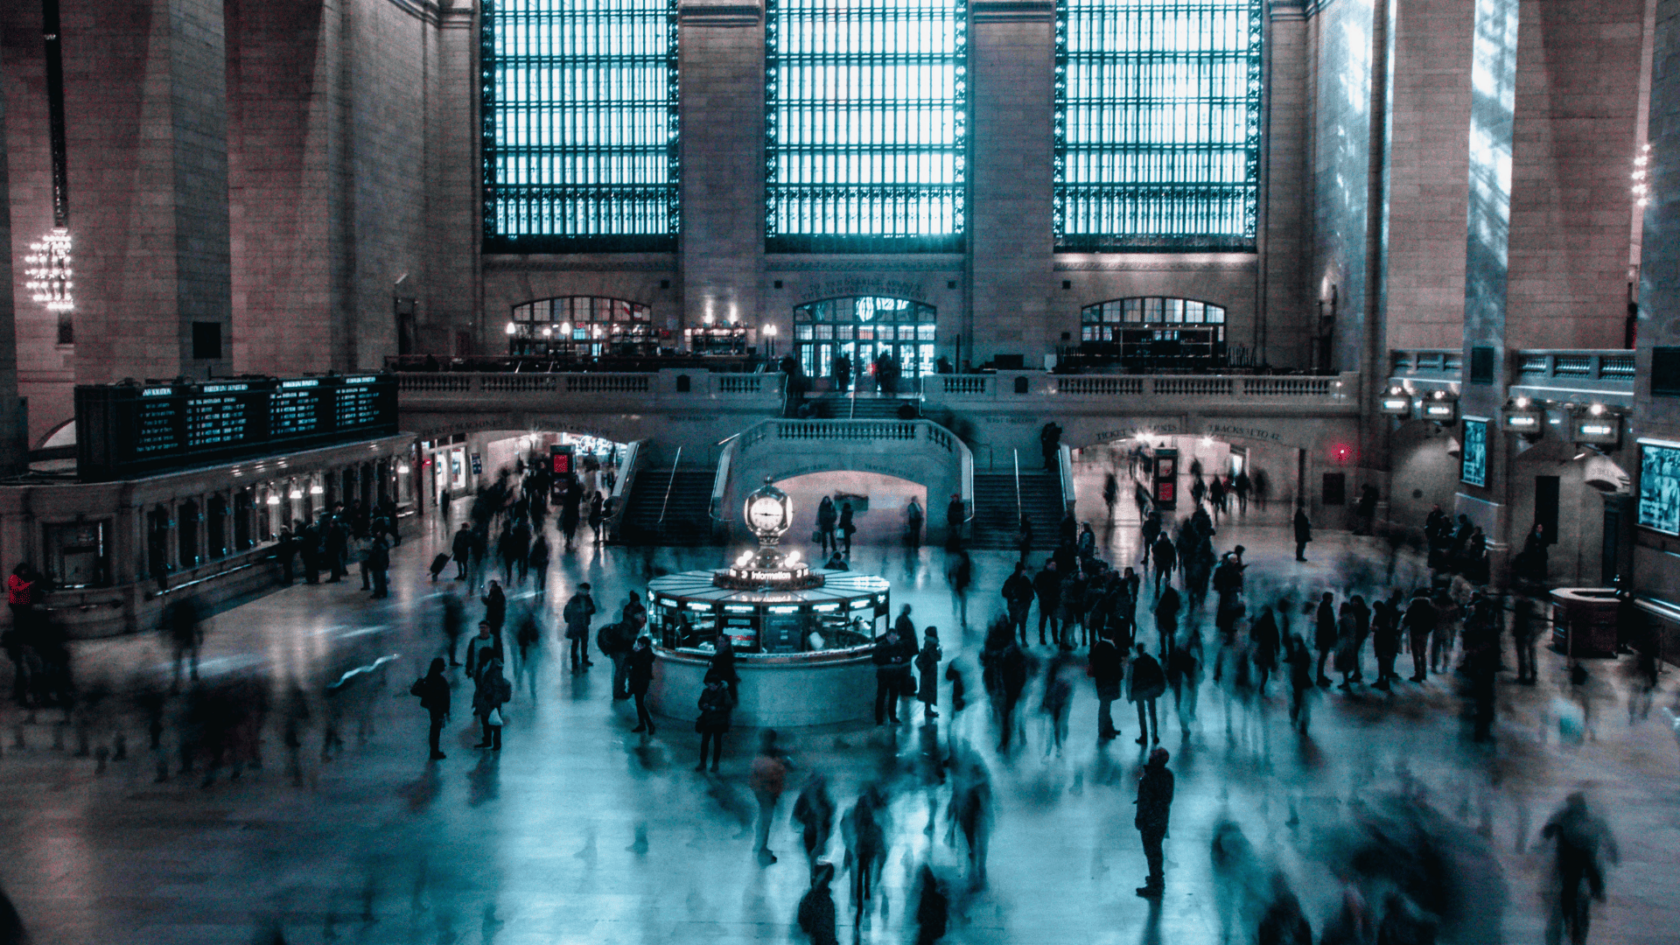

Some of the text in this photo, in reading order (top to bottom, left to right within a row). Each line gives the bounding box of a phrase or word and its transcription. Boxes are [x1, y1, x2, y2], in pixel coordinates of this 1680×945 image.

[1096, 428, 1126, 441] TICKET
[1208, 424, 1243, 434] TRACKS
[1256, 429, 1269, 438] TO
[751, 571, 791, 581] Information
